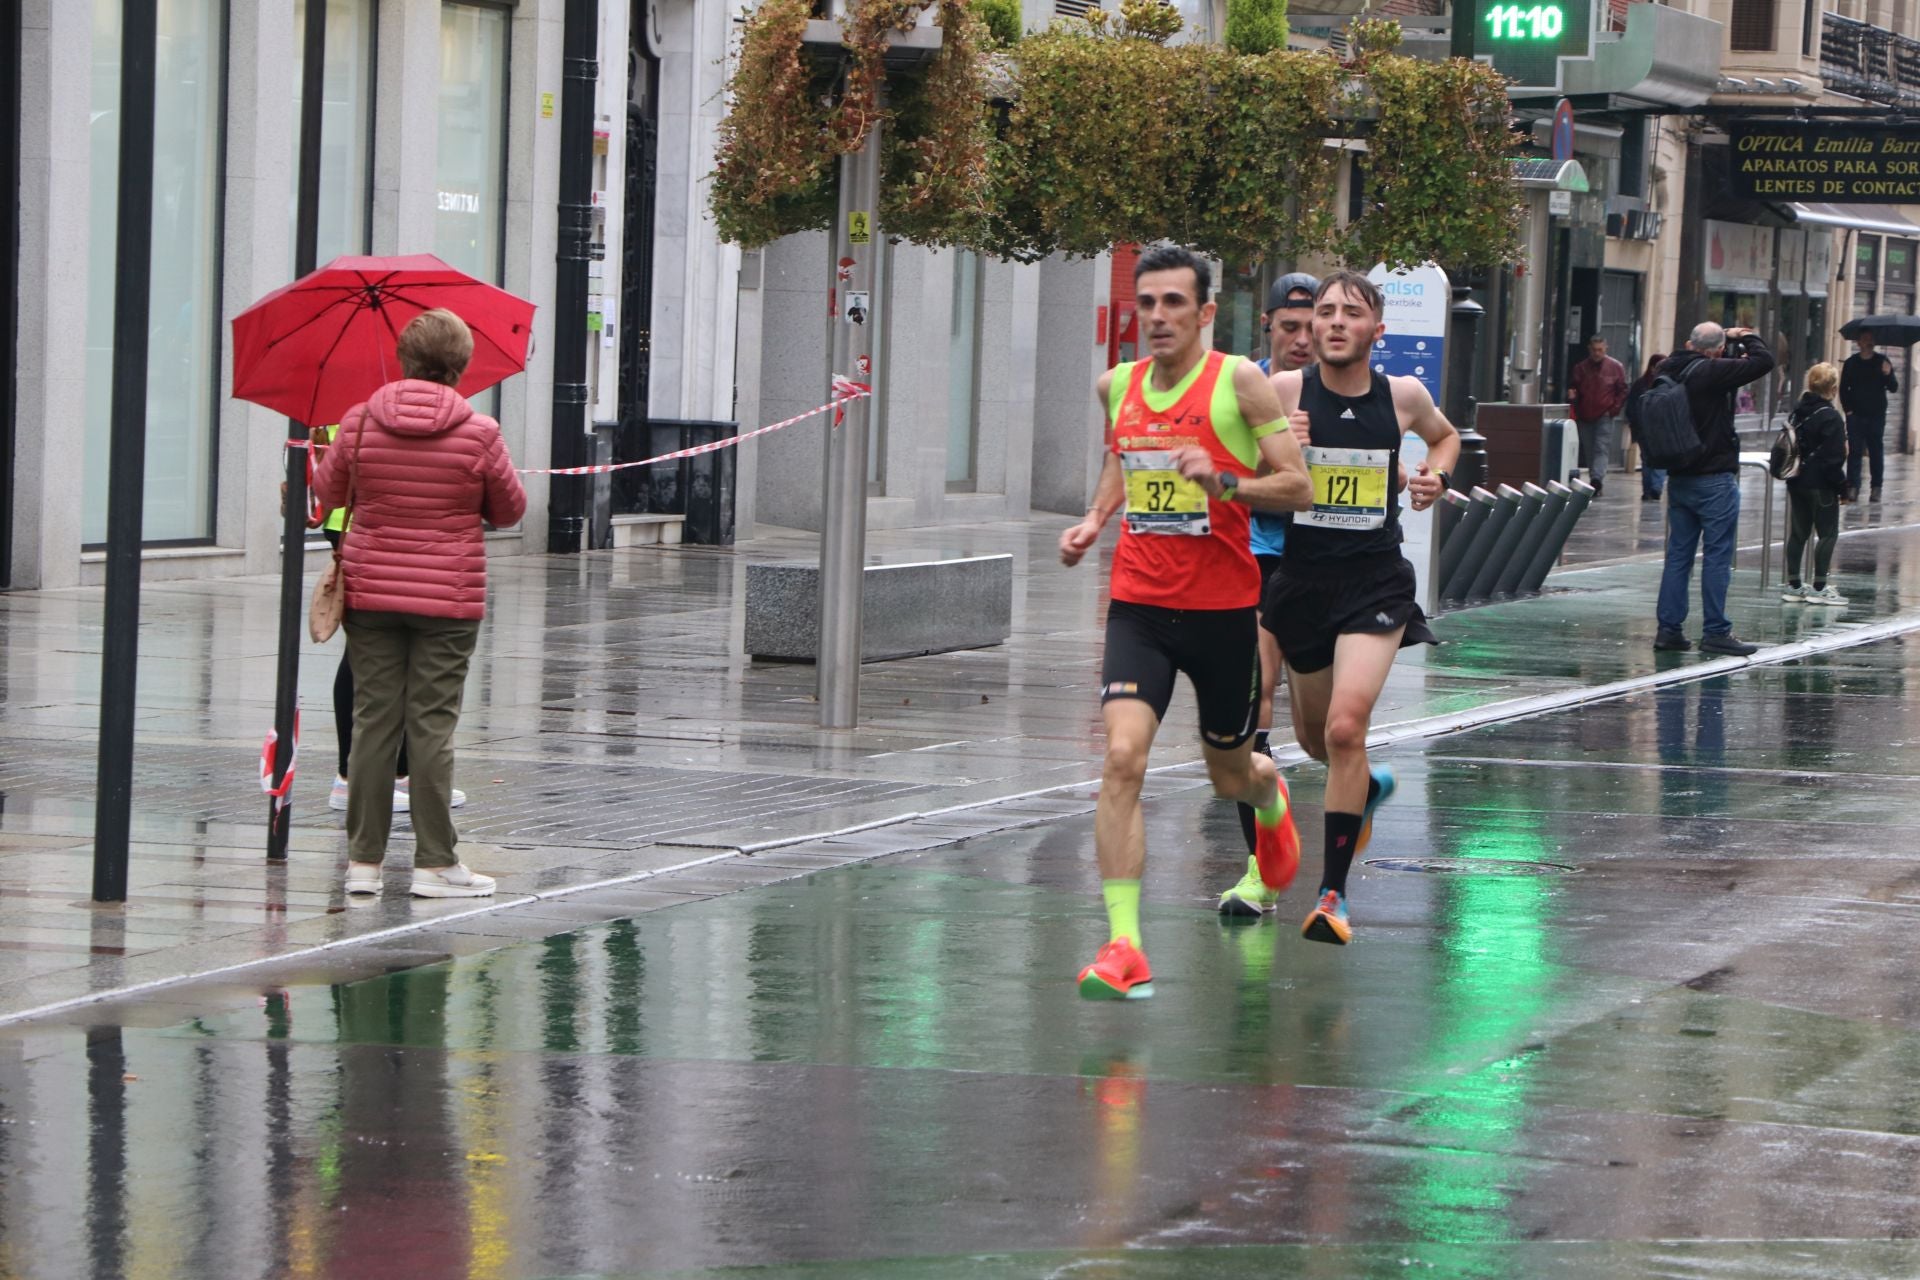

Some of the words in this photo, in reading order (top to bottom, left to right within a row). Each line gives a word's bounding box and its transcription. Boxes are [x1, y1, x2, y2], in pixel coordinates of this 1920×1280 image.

[1485, 5, 1563, 38] 11:10
[1738, 135, 1803, 151] OPTICA
[1814, 136, 1873, 153] Emilia
[1742, 159, 1828, 173] APARATOS
[1834, 160, 1878, 174] PARA
[1755, 180, 1816, 193] LENTES
[1823, 181, 1845, 194] DE
[1385, 280, 1424, 296] alsa
[1146, 480, 1176, 512] 32
[1327, 475, 1359, 505] 121
[1328, 514, 1371, 523] HYUNDAI
